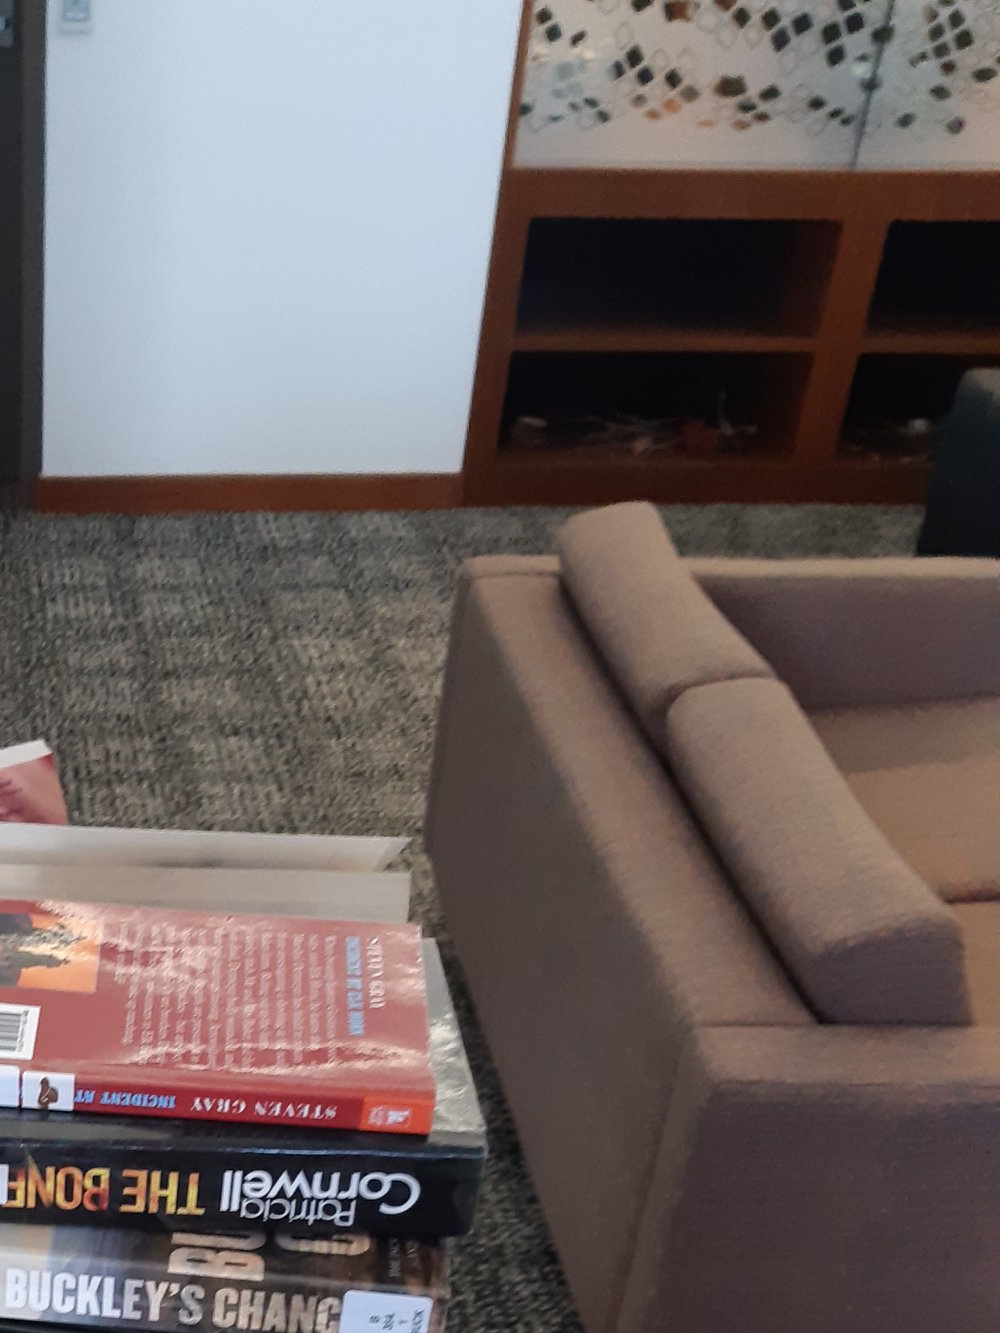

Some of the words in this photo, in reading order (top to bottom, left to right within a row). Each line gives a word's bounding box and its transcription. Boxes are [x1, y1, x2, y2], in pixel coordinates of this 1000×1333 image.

[100, 1090, 176, 1109] INCIDENT
[189, 1096, 248, 1115] GRAY
[253, 1100, 339, 1120] STEVEN
[119, 1168, 205, 1216] THE
[219, 1169, 422, 1215] Cornwell
[239, 1198, 357, 1227] Patricia
[5, 1267, 206, 1326] BUCKLEY'S
